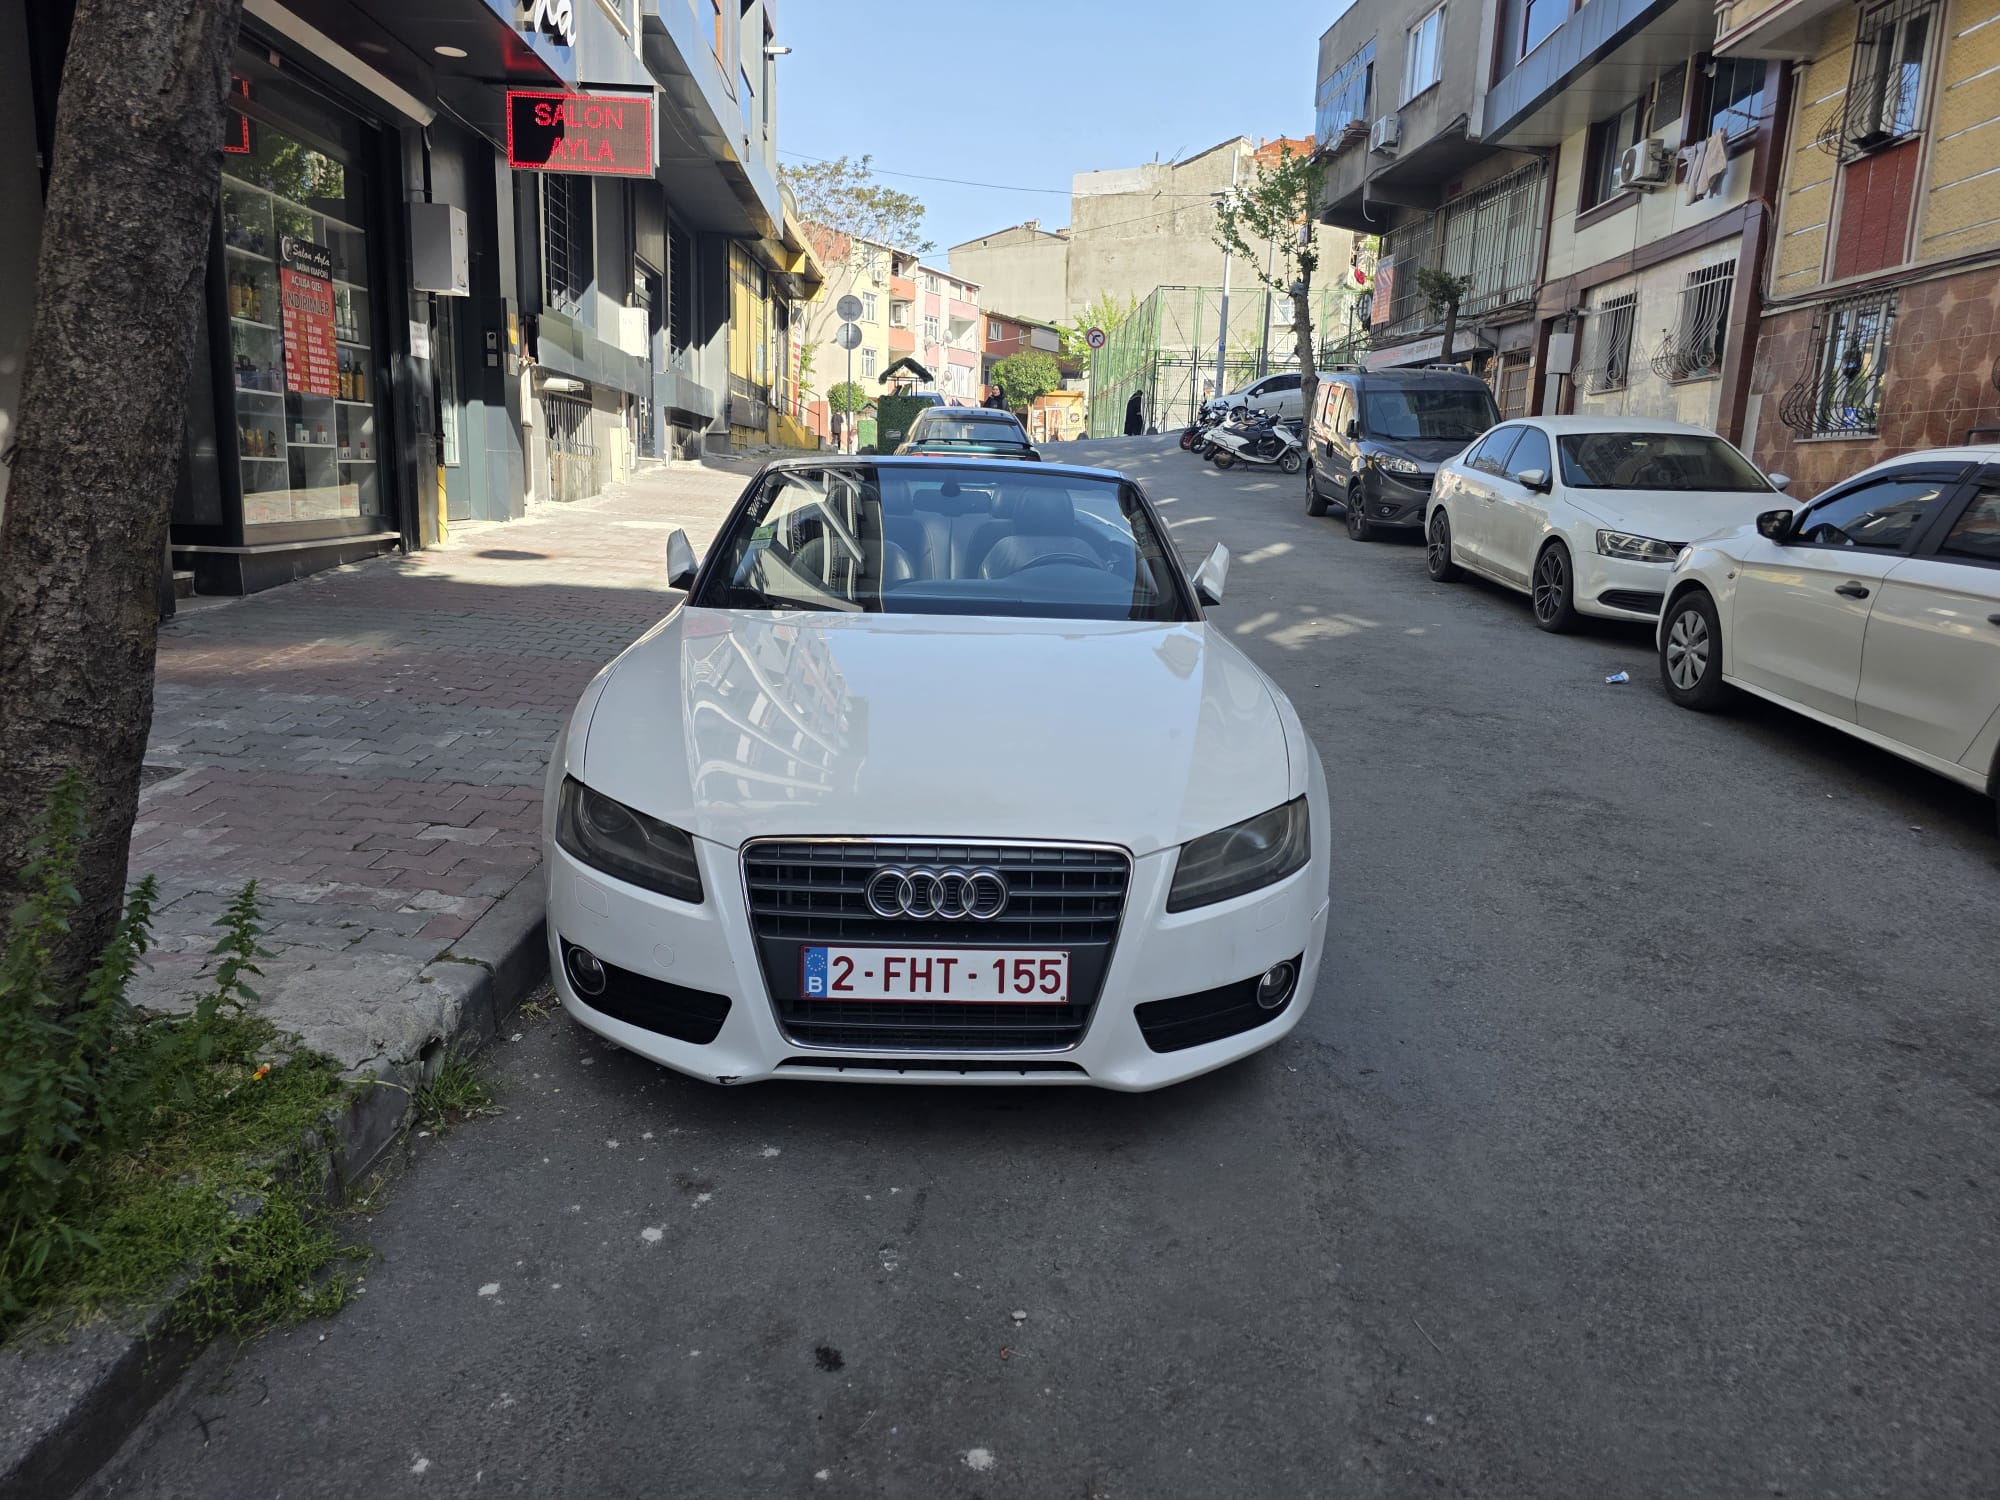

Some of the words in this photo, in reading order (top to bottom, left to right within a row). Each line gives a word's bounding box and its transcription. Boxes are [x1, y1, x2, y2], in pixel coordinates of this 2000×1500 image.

[534, 102, 623, 129] SALON
[550, 136, 614, 163] AYLA
[293, 244, 312, 261] Salon
[808, 976, 823, 993] B
[832, 955, 1062, 994] 2-FHT-155
